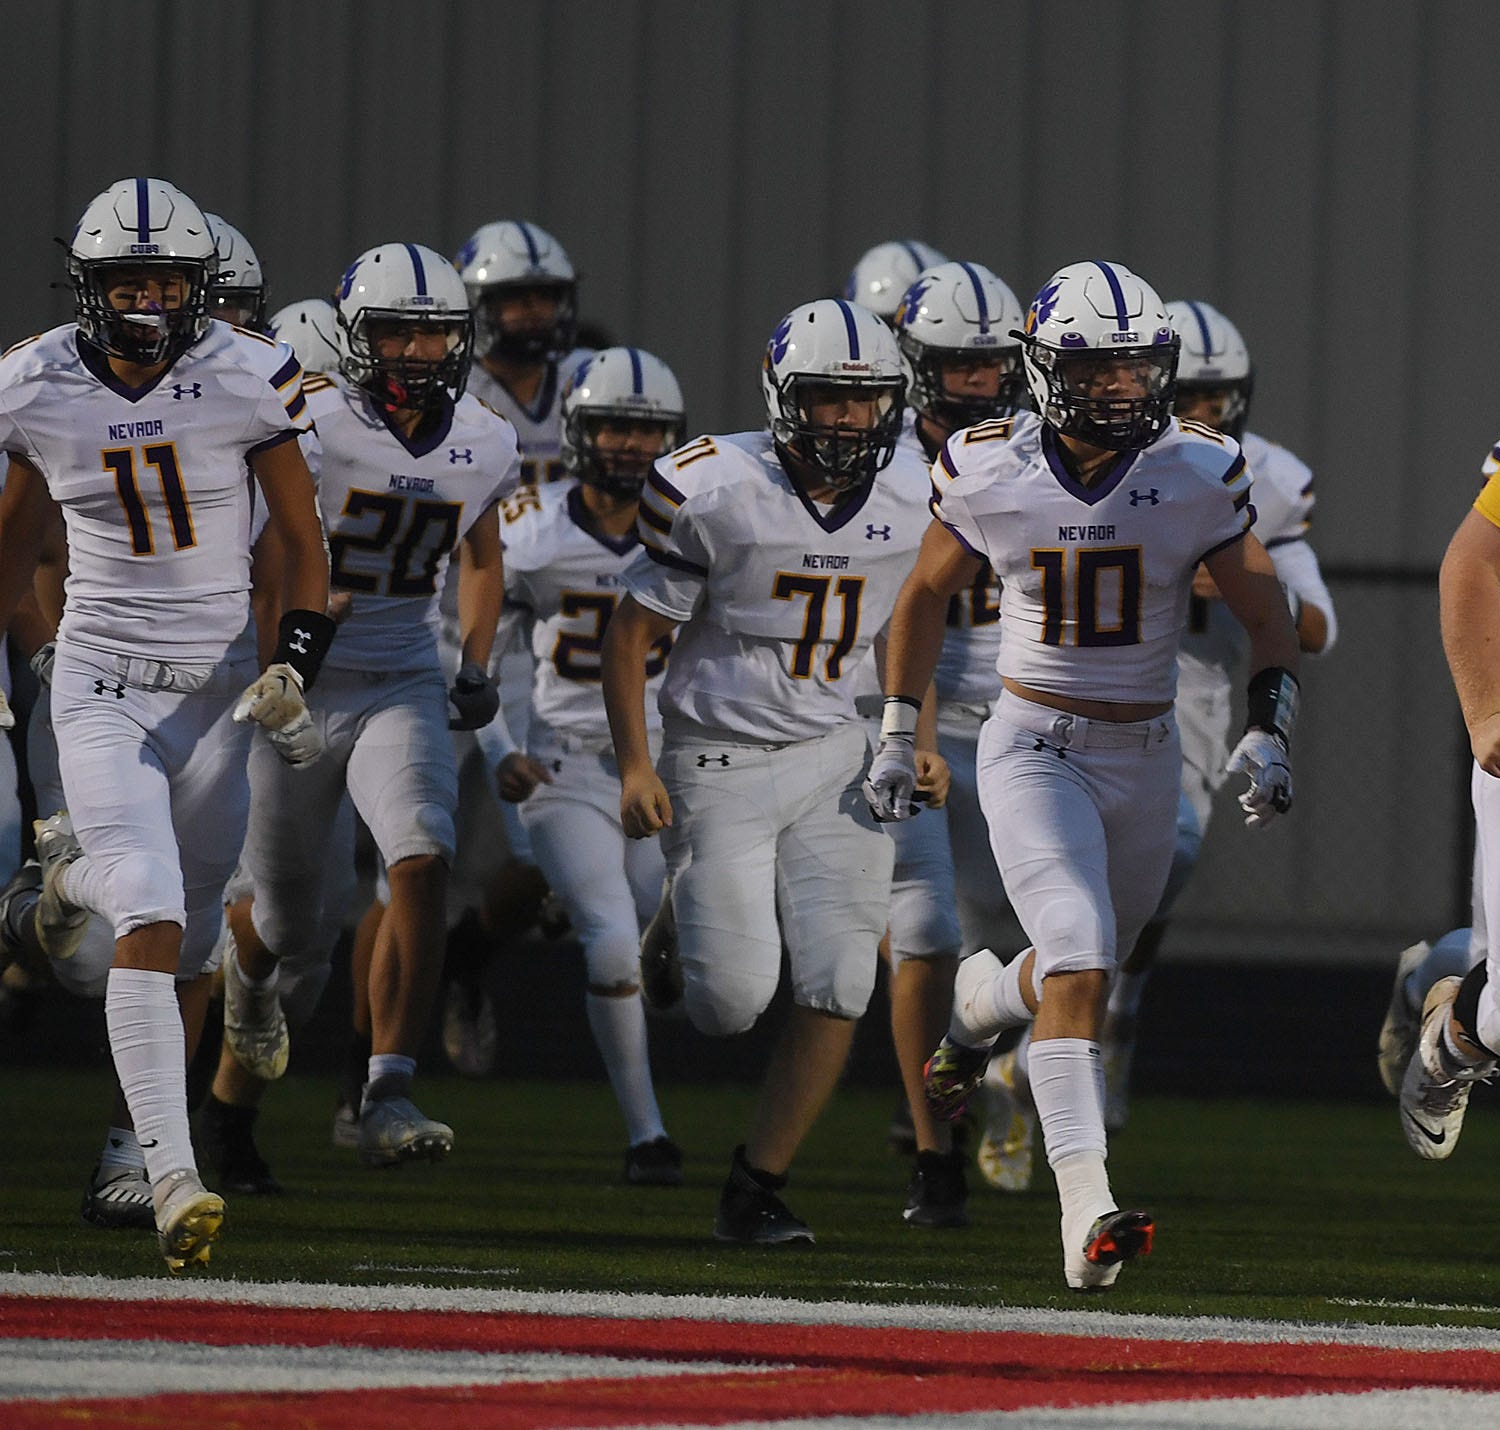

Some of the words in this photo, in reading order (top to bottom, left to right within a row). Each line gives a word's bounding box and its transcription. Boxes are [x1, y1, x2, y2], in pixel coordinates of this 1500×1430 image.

[130, 244, 159, 254] CUBS
[108, 419, 164, 440] NEVADA
[389, 475, 436, 493] NEVADA
[102, 441, 198, 557] 11
[1058, 525, 1117, 541] NEVADA
[329, 488, 466, 600] 20
[802, 553, 851, 570] NEVADA
[1031, 545, 1145, 649] 10
[772, 571, 866, 681] 71
